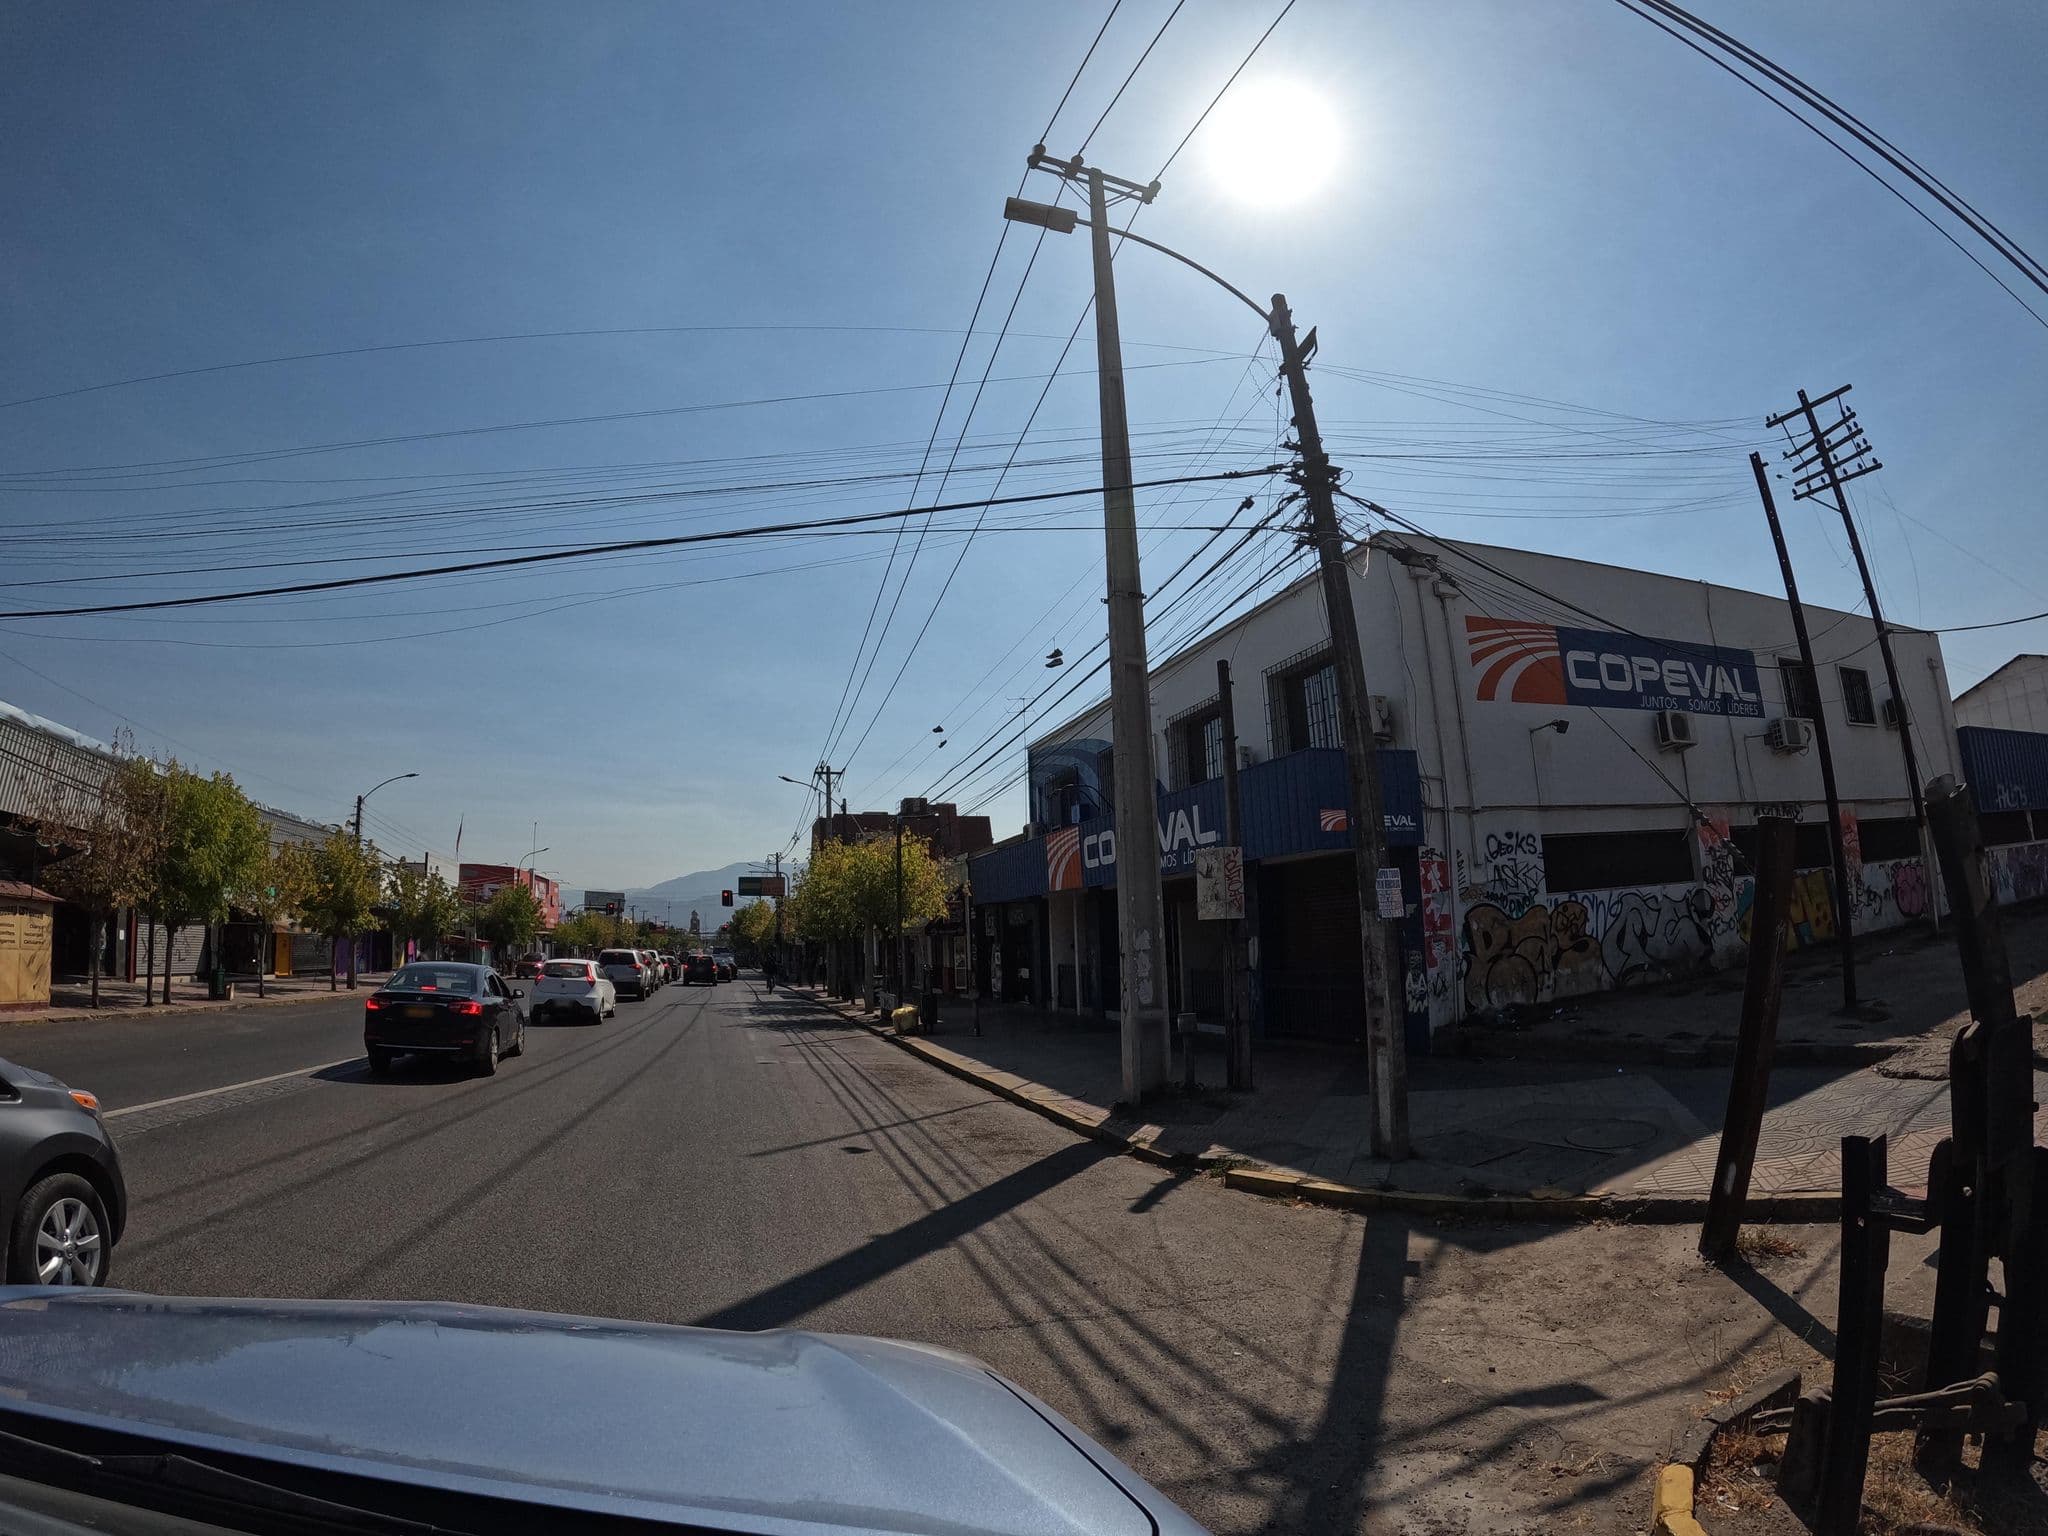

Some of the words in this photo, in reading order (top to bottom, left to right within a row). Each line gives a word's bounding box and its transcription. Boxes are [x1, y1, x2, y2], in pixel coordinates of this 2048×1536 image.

[1566, 650, 1758, 702] COPEVAL
[1640, 694, 1679, 710] JUNTOS
[1687, 698, 1722, 714] SOMOS
[1727, 700, 1760, 716] LÍDERES
[1083, 804, 1217, 869] COVAL
